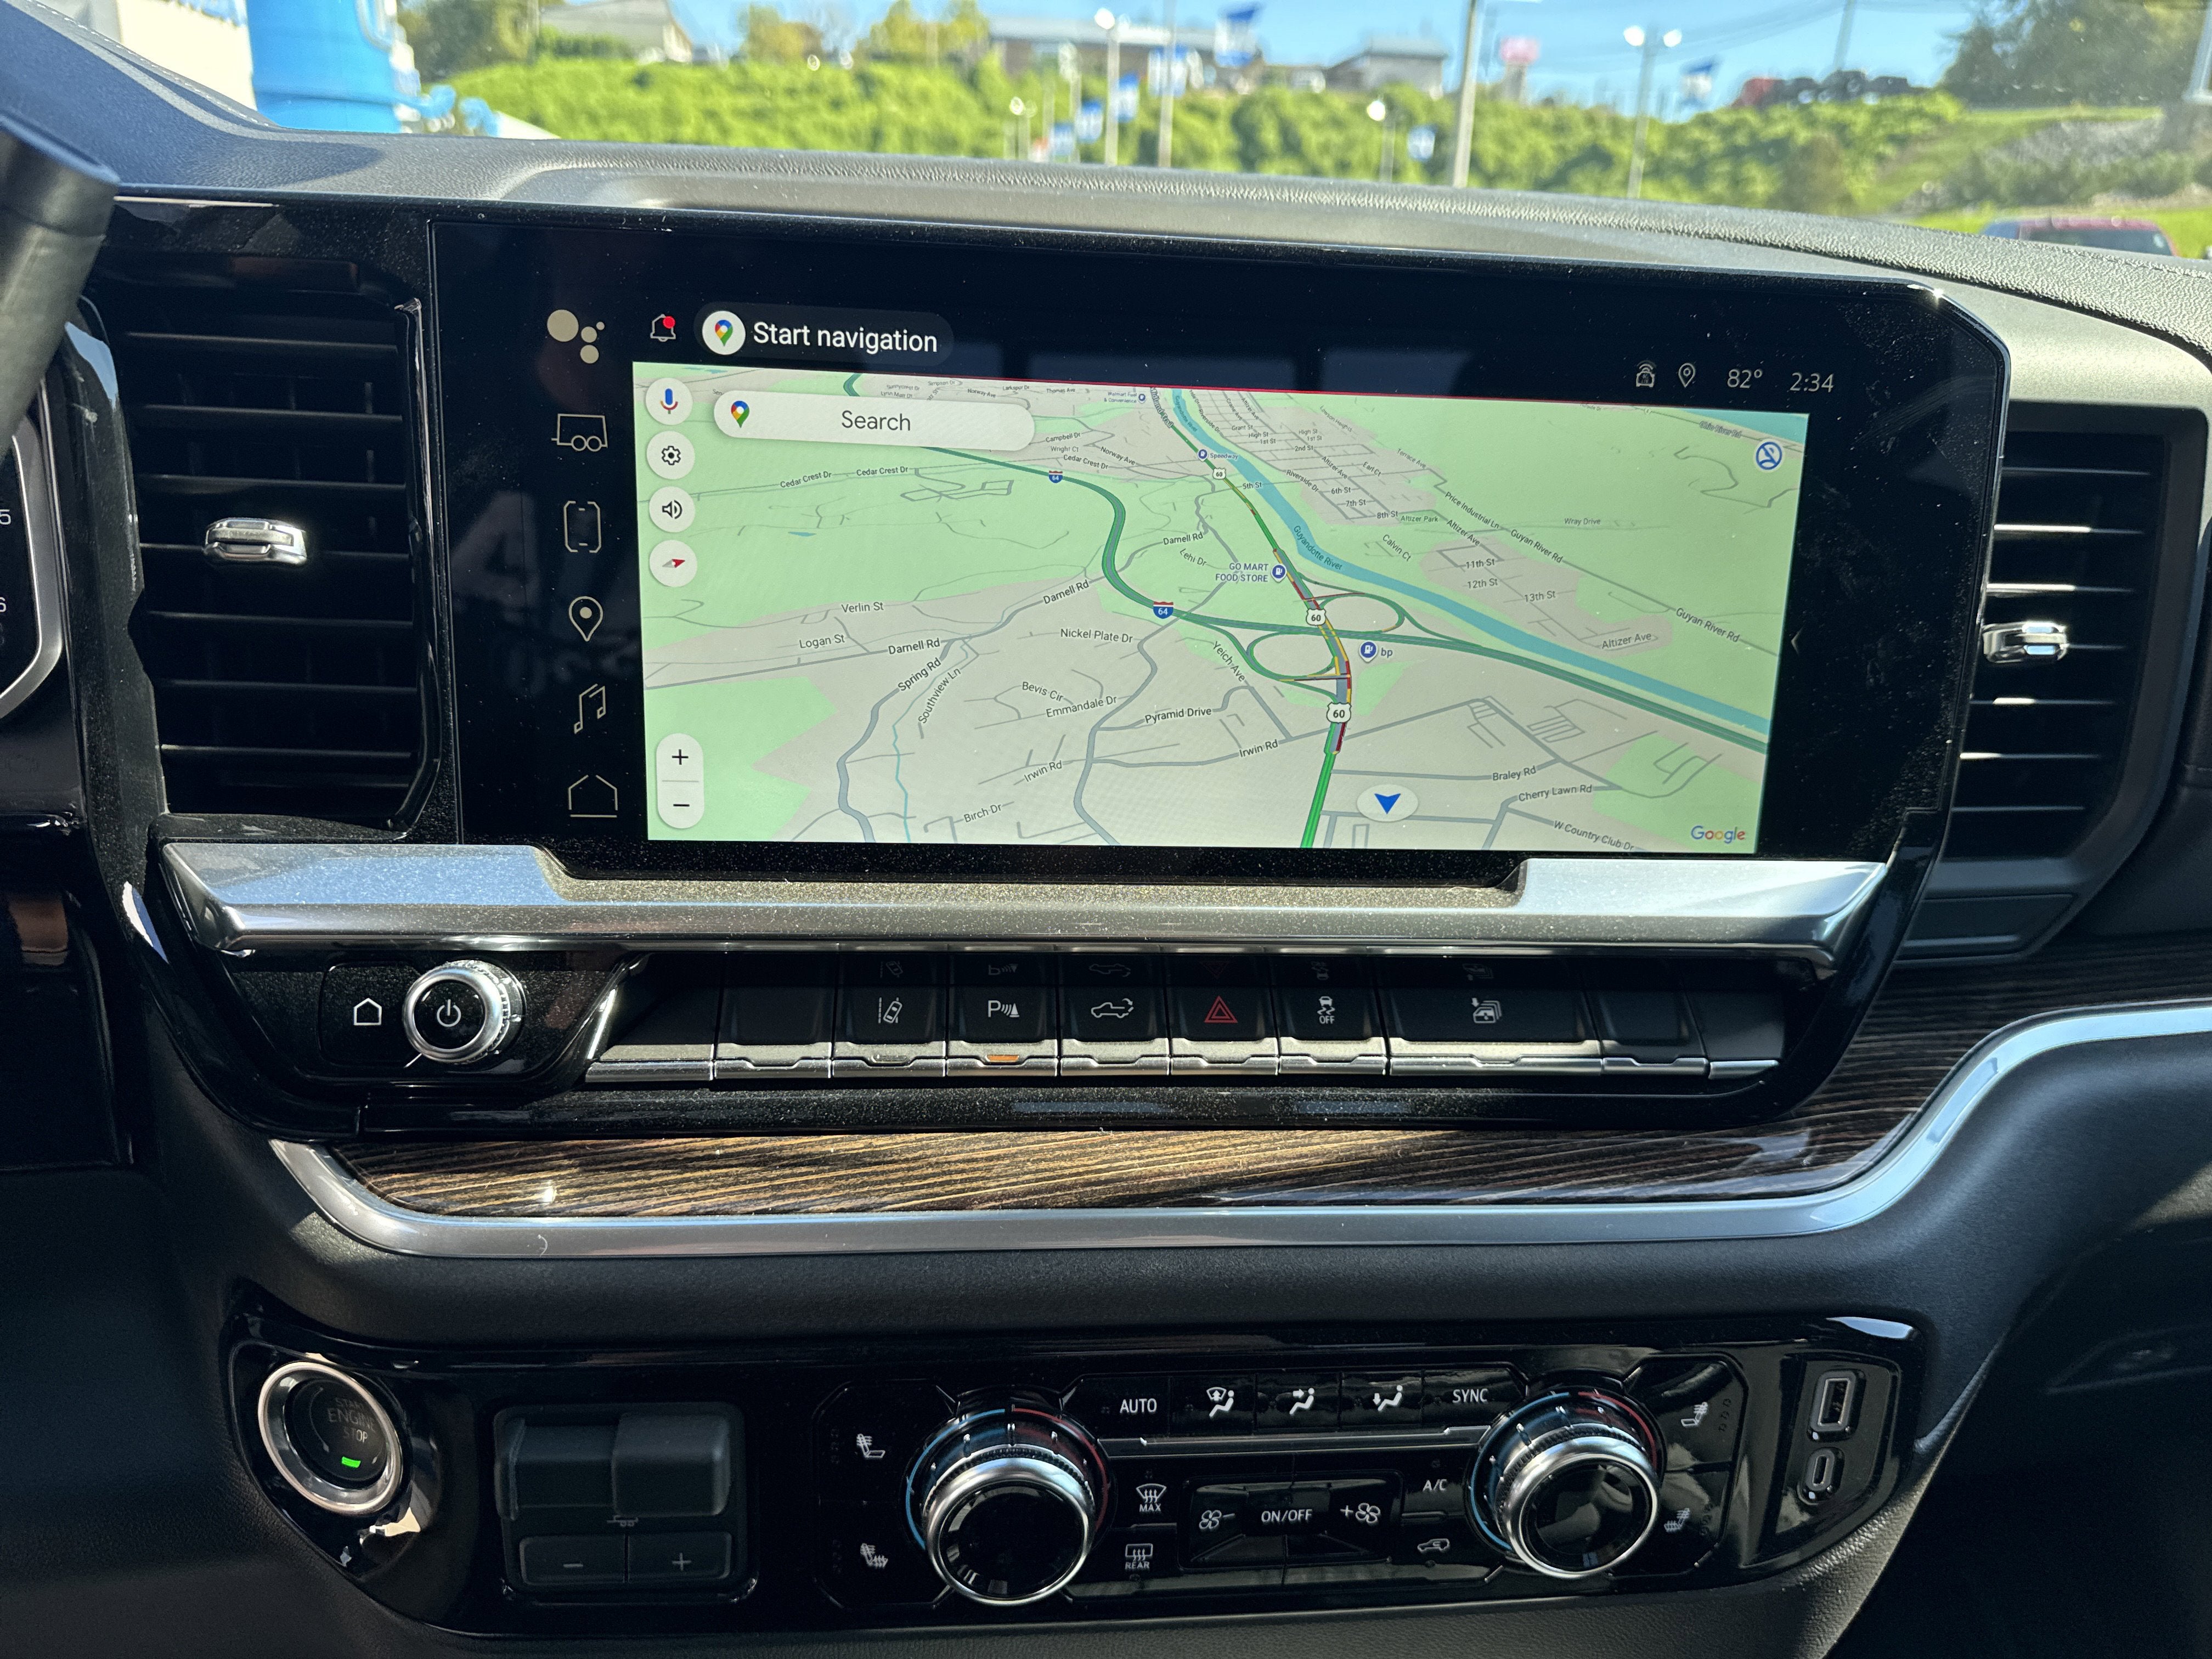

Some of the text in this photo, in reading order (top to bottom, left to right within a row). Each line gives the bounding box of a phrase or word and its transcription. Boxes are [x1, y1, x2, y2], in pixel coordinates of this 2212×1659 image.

[753, 321, 938, 354] Start navigation
[1727, 368, 1835, 393] 82° 2:34
[967, 388, 986, 396] Norway
[1226, 398, 1236, 413] Crane
[1241, 398, 1260, 421] Altizer Ave
[841, 410, 911, 431] Search
[1199, 409, 1215, 428] Riverside
[1045, 433, 1073, 443] Campbell
[1050, 445, 1070, 454] Wright
[1101, 446, 1136, 466] Norway Ave
[1210, 452, 1239, 460] Speedway
[1063, 454, 1082, 463] Cedar
[1083, 458, 1098, 468] Crest
[1321, 456, 1348, 479] Altizer Ave
[1397, 448, 1426, 470] Terrace Ave
[856, 468, 878, 476] Cedar
[879, 466, 899, 475] Crest
[1362, 461, 1382, 477] Earl Ct
[780, 478, 802, 488] Cedar
[803, 472, 822, 483] Crest
[1286, 469, 1319, 492] Riverside Dr
[1445, 491, 1500, 529] Price Industrial Ln
[1564, 517, 1601, 527] Wray Drive
[1192, 532, 1204, 541] Rd
[1446, 519, 1481, 546] Altizer Ave
[1294, 525, 1342, 570] Guyandotte River
[1382, 533, 1412, 562] Calvin Ct
[1510, 528, 1564, 563] Guyan River Rd
[1180, 548, 1208, 567] Lehi Dr
[1465, 558, 1496, 569] 11th St
[1228, 562, 1269, 572] GO MART
[1215, 573, 1268, 583] FOOD STORE
[1467, 578, 1498, 589] 12th St
[1042, 579, 1090, 605] Darnell Rd
[1523, 590, 1556, 603] 13th St
[841, 602, 885, 613] Verlin St
[1158, 607, 1168, 616] 64
[1311, 614, 1321, 622] 60
[1675, 607, 1741, 643] Guyan River Rd
[799, 634, 845, 649] Logan St
[1060, 628, 1133, 643] Nickel Plate Dr
[1601, 632, 1652, 650] Altizer Ave
[888, 637, 940, 655] Darnell Rd
[1380, 647, 1393, 658] bp
[1212, 640, 1246, 682] Yeich Ave
[897, 657, 941, 692] Spring Rd
[918, 668, 961, 724] Southview Ln
[1022, 681, 1064, 703] Bevis Cir
[1046, 695, 1118, 718] Emmandale Dr
[1333, 709, 1345, 718] 60
[1144, 707, 1212, 724] Pyramid Drive
[1238, 738, 1279, 759] Irwin Rd
[1023, 760, 1063, 783] Irwin Rd
[1492, 765, 1537, 781] Braley Rd
[1518, 783, 1593, 802] Cherry Lawn Rd
[963, 803, 1002, 823] Birch Dr
[1554, 820, 1635, 851] W Country Club Dr
[1690, 825, 1746, 844] Google
[1318, 1015, 1335, 1025] OFF
[1452, 1388, 1488, 1404] SYNC
[1119, 1398, 1158, 1414] AUTO
[342, 1426, 368, 1443] STOP
[1423, 1478, 1448, 1492] A/C
[1139, 1503, 1162, 1513] MAX
[1261, 1509, 1313, 1524] ON/OFF
[1125, 1561, 1150, 1570] REAR
